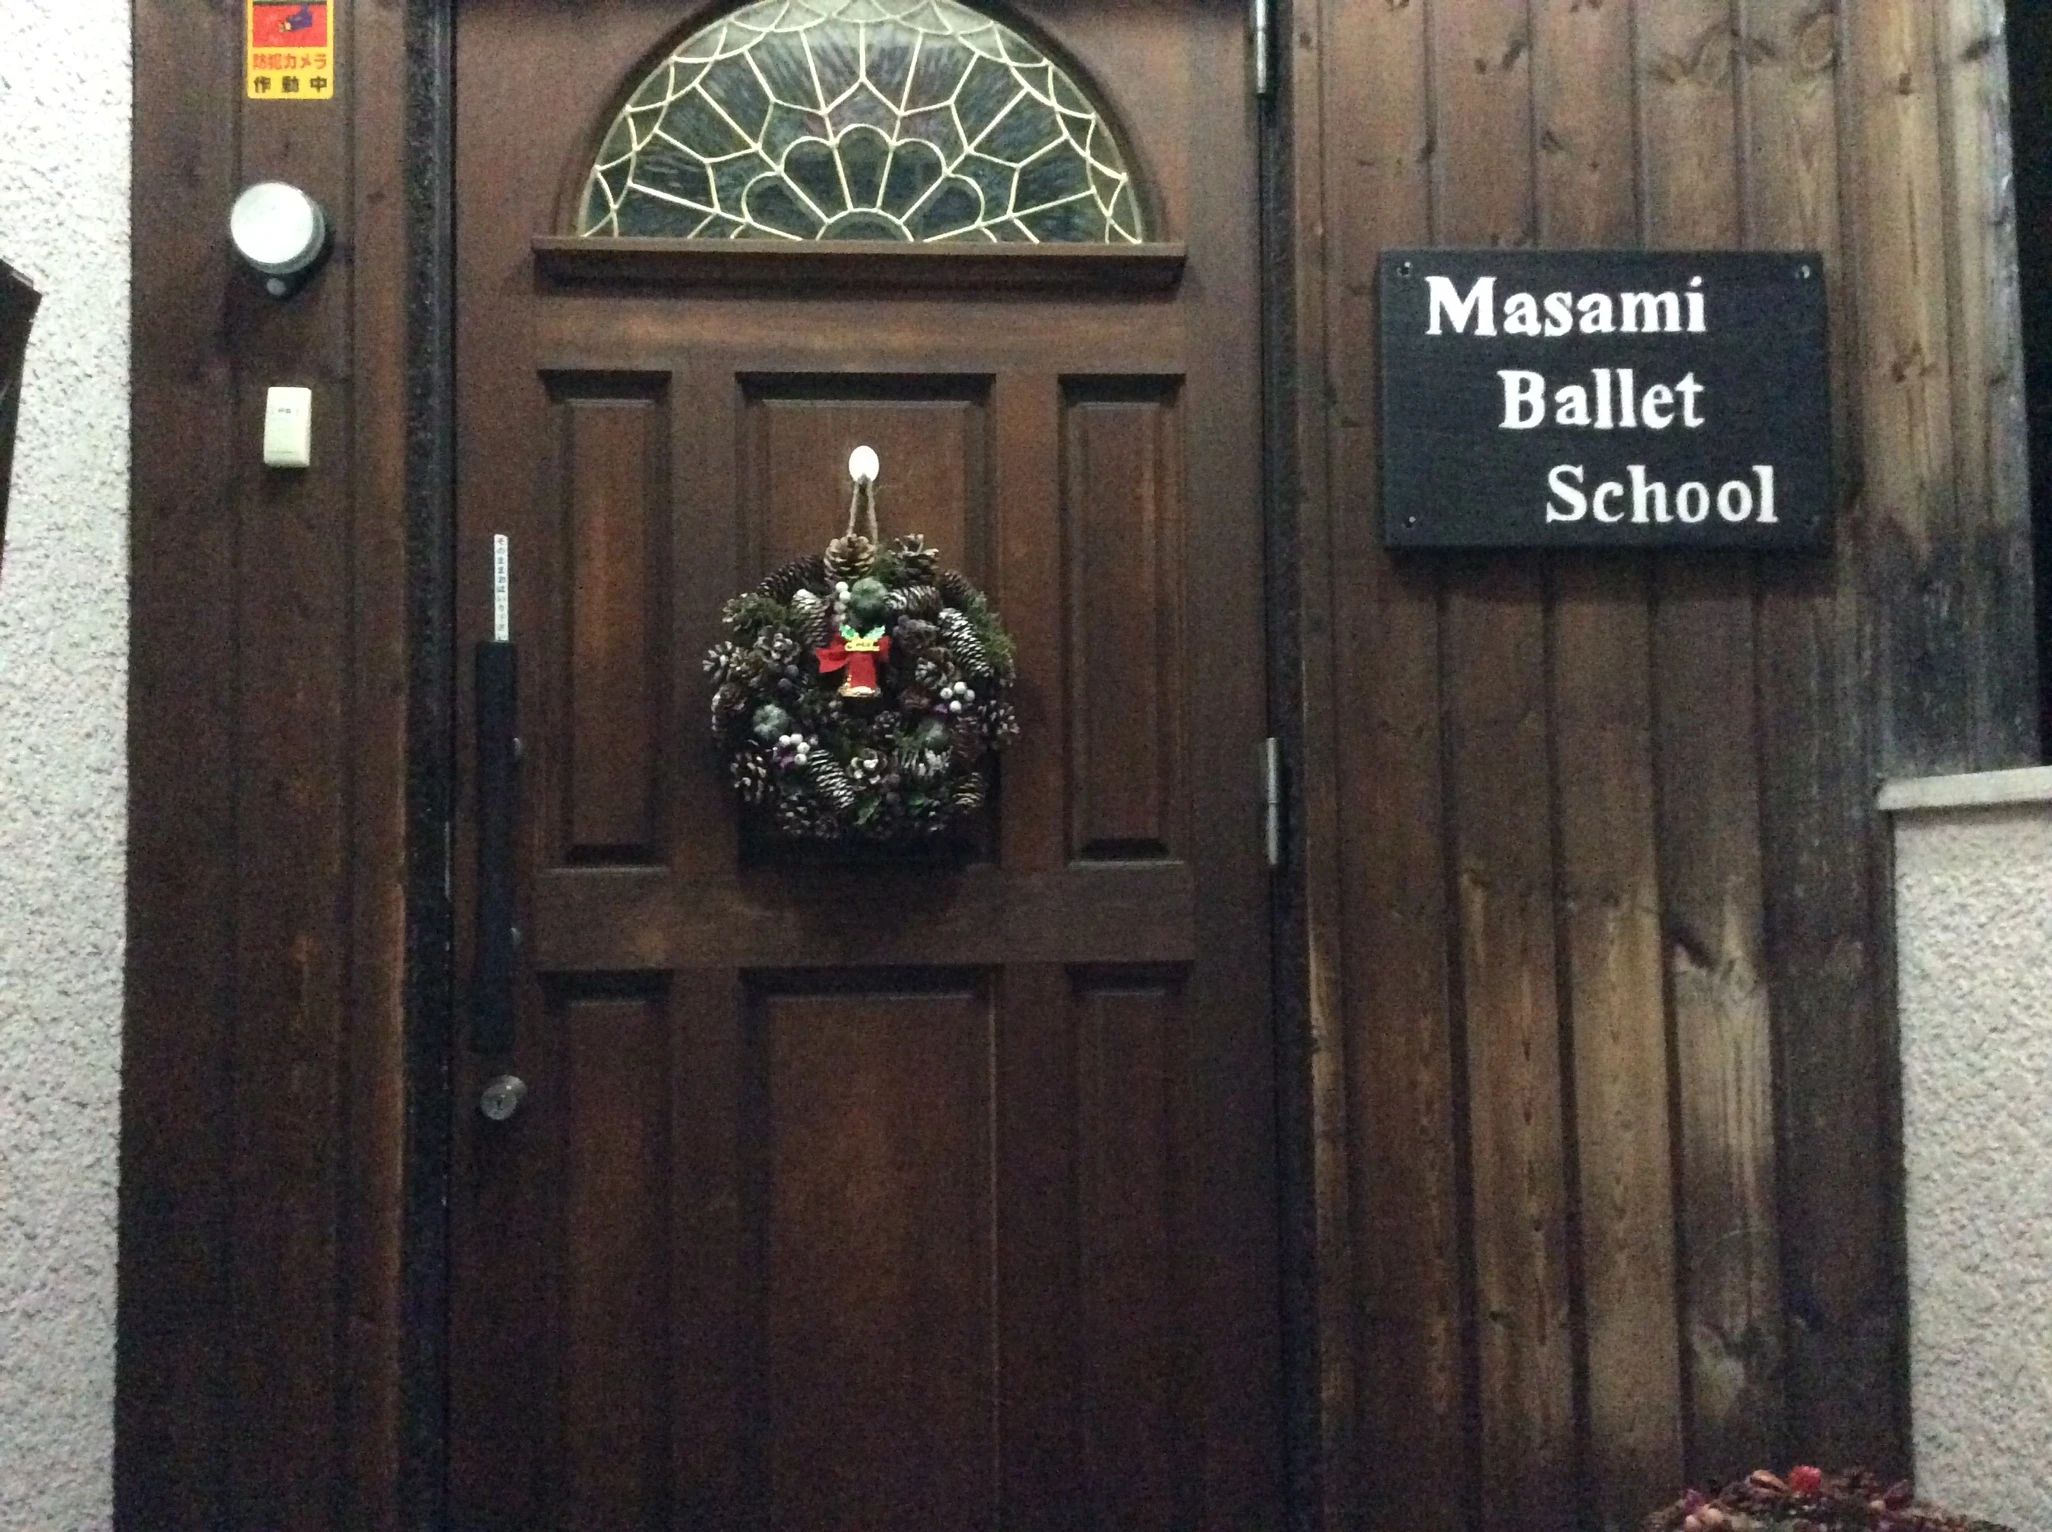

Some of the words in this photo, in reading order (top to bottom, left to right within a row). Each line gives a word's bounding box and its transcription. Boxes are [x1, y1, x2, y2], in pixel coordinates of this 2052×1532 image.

[254, 75, 328, 94] 作動中
[1424, 275, 1707, 337] Masami
[1496, 367, 1705, 430] Ballet
[1545, 464, 1778, 524] School
